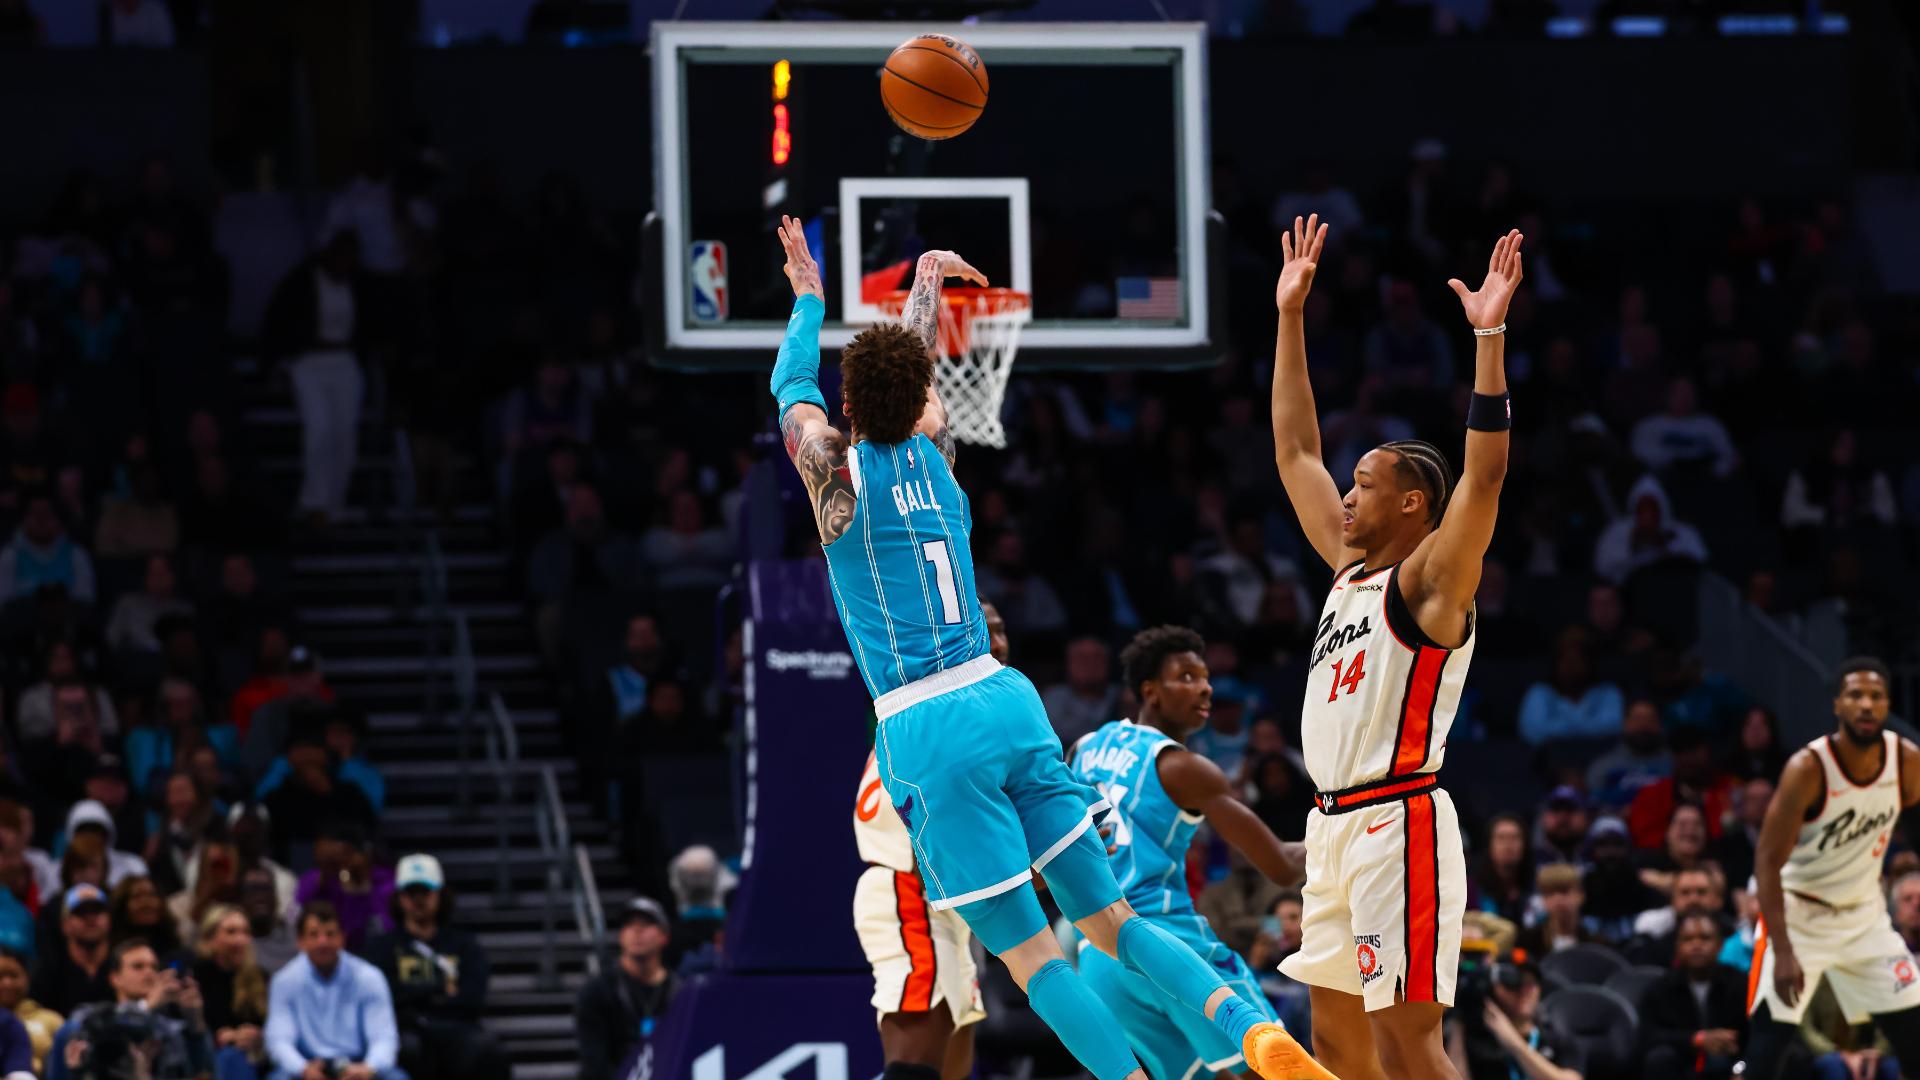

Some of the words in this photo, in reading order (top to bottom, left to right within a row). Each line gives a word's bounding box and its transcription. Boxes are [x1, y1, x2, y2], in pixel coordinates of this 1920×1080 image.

[891, 480, 942, 516] BALL
[922, 540, 963, 625] 1
[1328, 649, 1366, 703] 14
